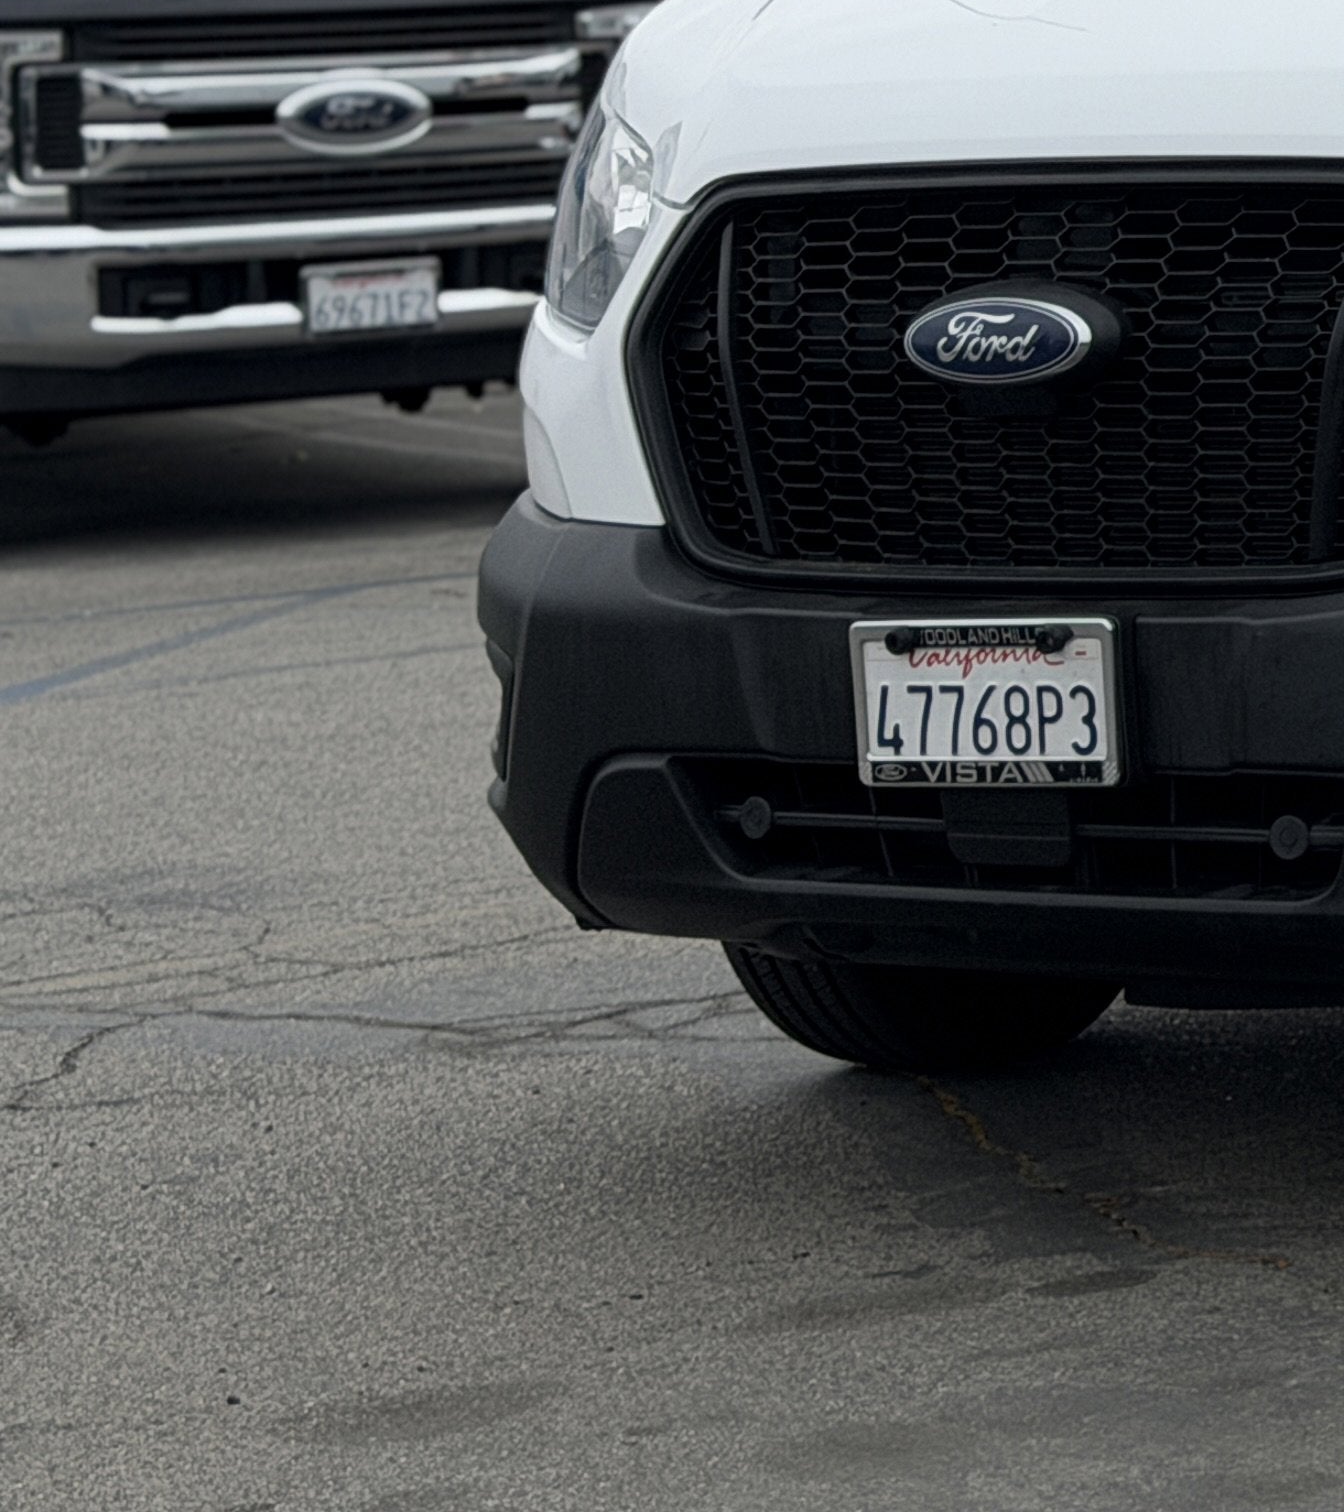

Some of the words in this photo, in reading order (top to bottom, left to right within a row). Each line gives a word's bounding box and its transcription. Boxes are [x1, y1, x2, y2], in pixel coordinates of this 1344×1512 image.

[936, 311, 1039, 362] Ford
[876, 684, 1098, 756] 47768P3
[920, 761, 1026, 783] VISTA
